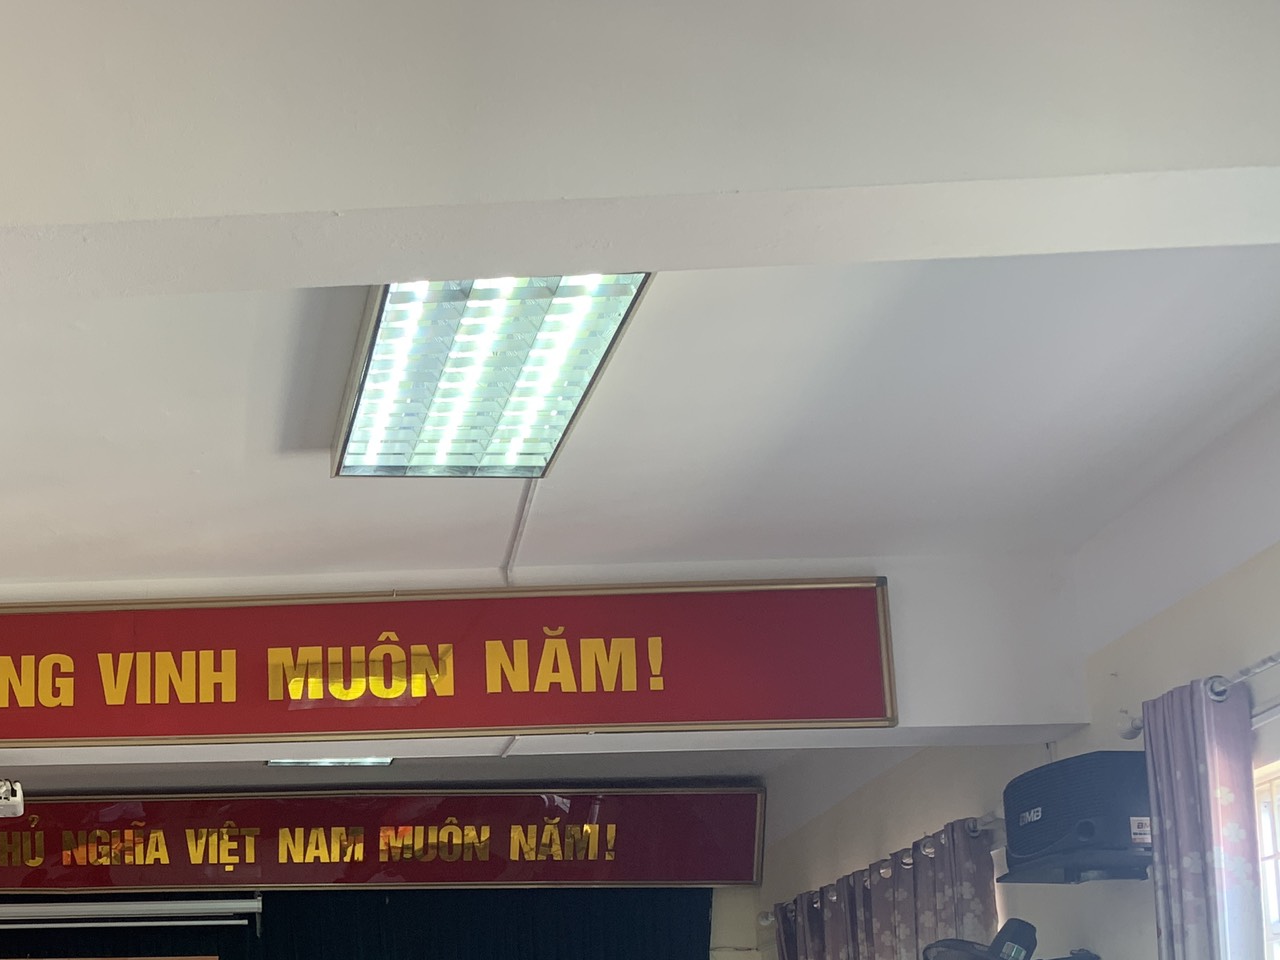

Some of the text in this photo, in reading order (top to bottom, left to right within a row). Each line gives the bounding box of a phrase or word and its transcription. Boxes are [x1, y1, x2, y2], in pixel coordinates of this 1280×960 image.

[97, 649, 237, 705] VINH
[267, 631, 454, 701] MUÔN
[485, 626, 665, 695] NĂM!
[62, 820, 170, 867] NGHĨA
[184, 820, 260, 872] VIỆT
[278, 826, 364, 863] NAM
[379, 817, 491, 863] MUÔN
[510, 816, 616, 862] NĂM!
